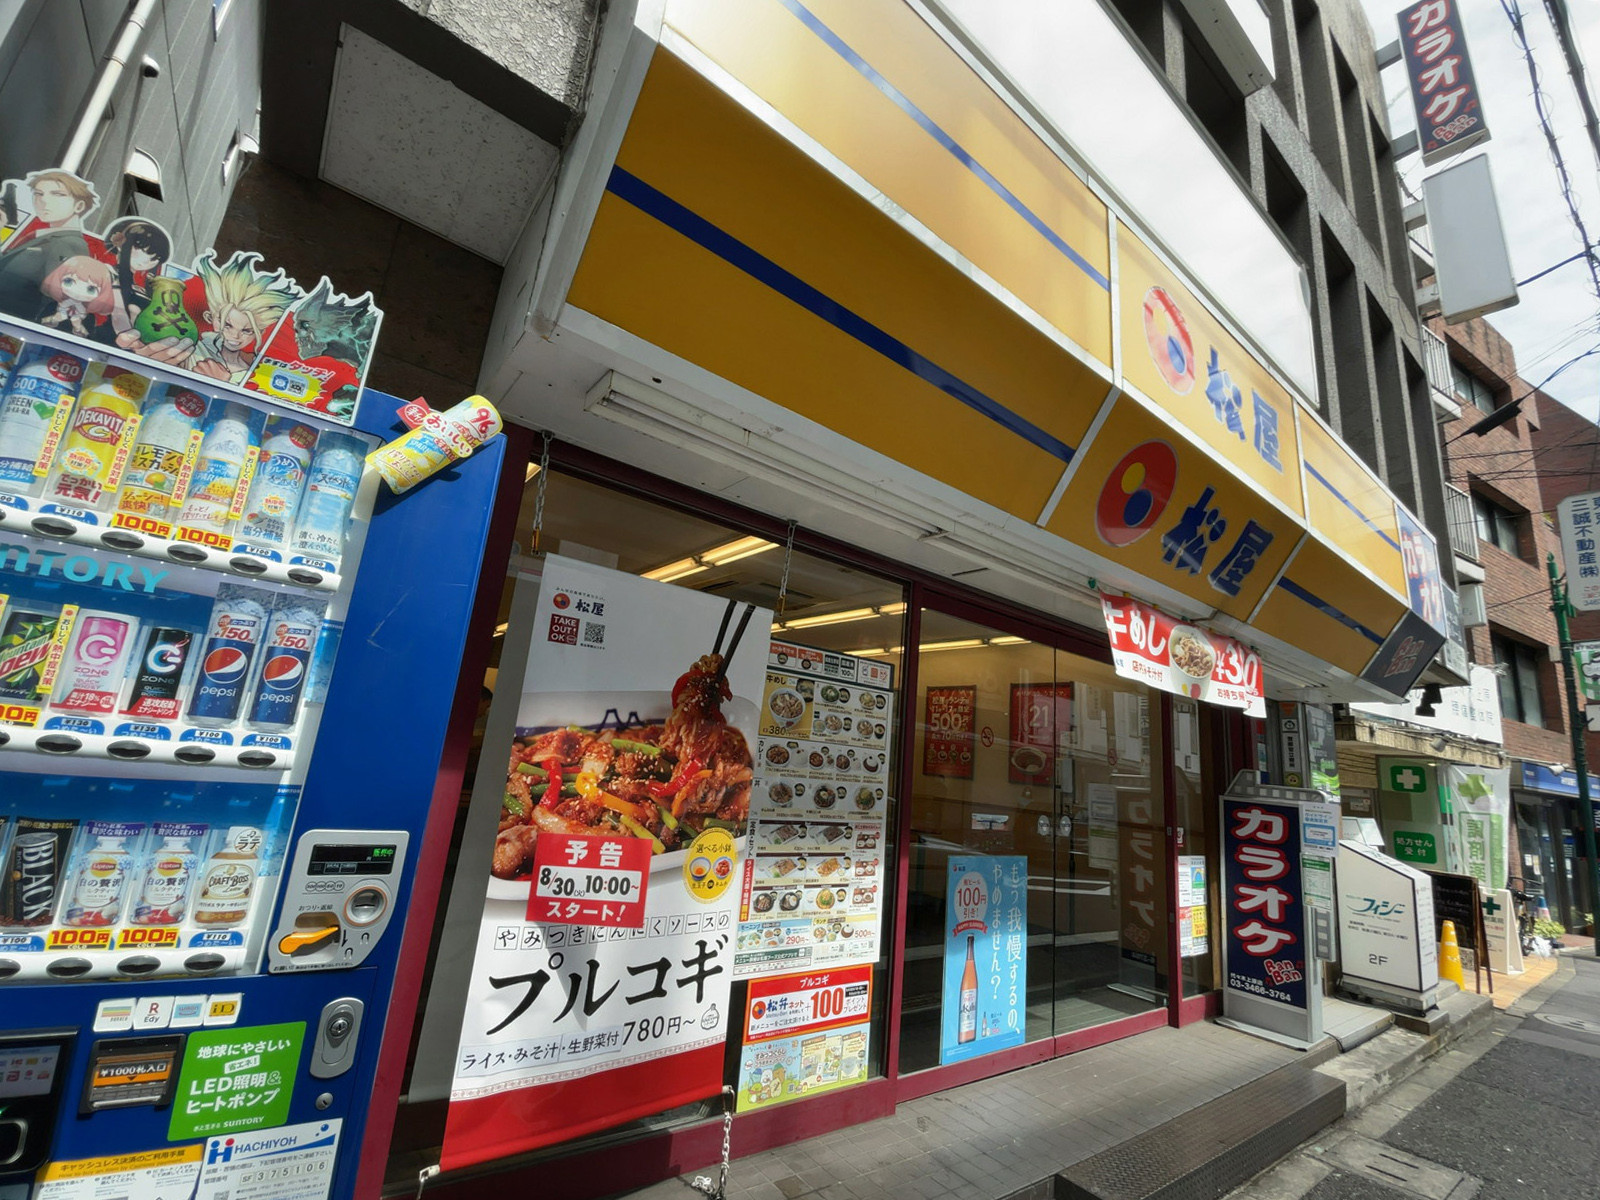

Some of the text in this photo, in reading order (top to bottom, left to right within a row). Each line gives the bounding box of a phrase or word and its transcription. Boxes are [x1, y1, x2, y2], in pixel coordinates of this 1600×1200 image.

[1409, 0, 1468, 124] カラオケ
[51, 361, 80, 377] 600
[12, 377, 38, 391] 600
[1205, 344, 1283, 475] 松屋
[426, 413, 472, 455] おいしい
[60, 473, 103, 490] でっかい
[53, 482, 102, 504] 元気!
[115, 513, 170, 537] 100円
[179, 527, 232, 548] 100円
[1160, 484, 1275, 598] 松屋
[249, 547, 270, 556] ¥100
[305, 558, 325, 567] ¥100
[574, 598, 605, 617] 松屋
[553, 615, 577, 627] TAKE
[1102, 600, 1167, 657] 牛めし
[551, 624, 577, 636] OUT!
[551, 632, 566, 642] OK
[1215, 643, 1259, 691] ¥30
[766, 674, 787, 686] 牛めし
[199, 685, 237, 698] pepsi
[259, 692, 294, 704] pepsi
[199, 731, 221, 739] ¥100
[259, 735, 280, 743] ¥100
[237, 838, 261, 851] ラテ
[372, 848, 394, 858] 販売中
[564, 839, 623, 868] 予告
[22, 841, 54, 920] BLACK
[1233, 807, 1293, 955] カラオケ
[957, 886, 987, 907] 100円
[546, 900, 627, 923] スタート!
[51, 929, 111, 945] 100円
[121, 928, 177, 943] 100円
[1264, 959, 1295, 976] Ban
[1369, 953, 1389, 966] 2F
[486, 933, 730, 1036] プルコギ
[799, 974, 830, 989] プルコギ
[1271, 969, 1303, 986] Ban
[212, 1003, 236, 1014] iD
[810, 987, 845, 1020] 100
[143, 1015, 161, 1024] Edy
[620, 1015, 697, 1046] 780円〜
[196, 1038, 292, 1060] 地球にやさしい
[461, 1029, 621, 1071] ライス・みそ汁・生野菜付
[99, 1062, 167, 1077] ¥1000札入口
[189, 1069, 283, 1096] LED照明&
[185, 1087, 281, 1115] ヒートポンプ
[222, 1115, 266, 1128] SUNTORY
[234, 1135, 298, 1155] HACHIYOH
